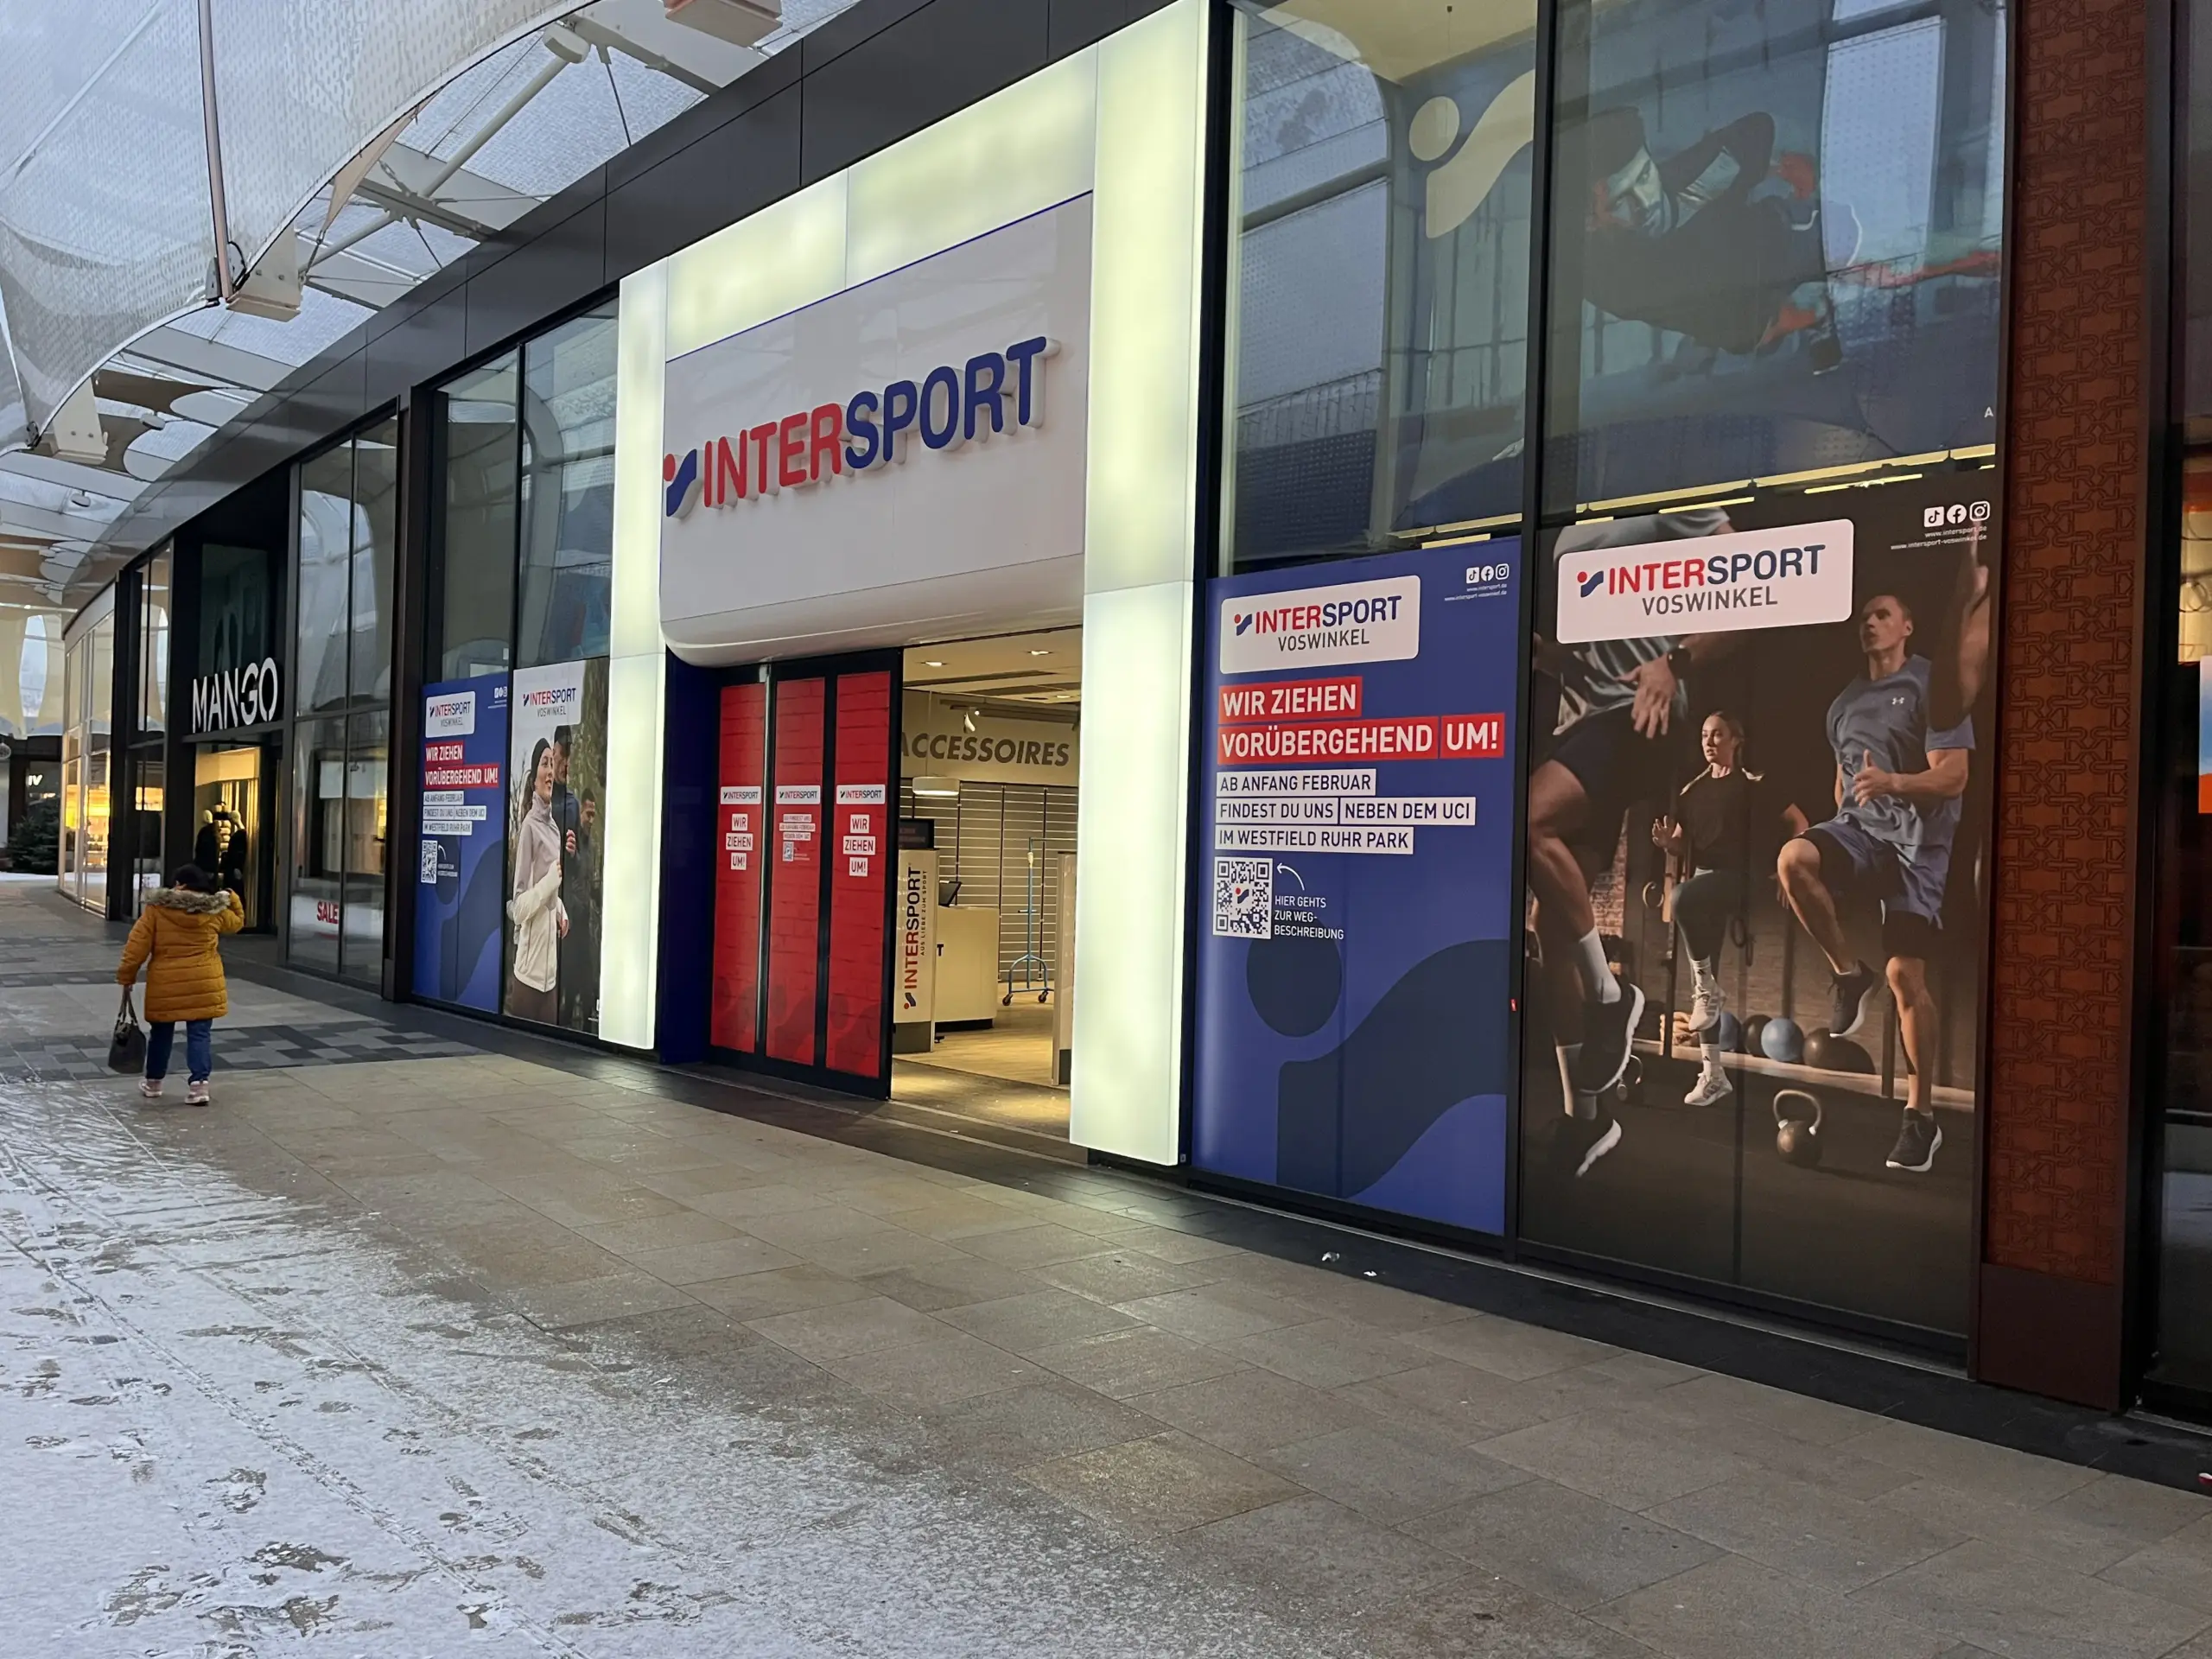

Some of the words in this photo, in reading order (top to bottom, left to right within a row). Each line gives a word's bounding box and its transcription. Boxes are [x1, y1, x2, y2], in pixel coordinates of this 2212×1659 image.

[702, 335, 1047, 508] INTERSPORT
[1608, 543, 1826, 595] INTERSPORT
[1642, 586, 1778, 616] VOSWINKEL
[1255, 595, 1402, 634] INTERSPORT
[1278, 628, 1370, 652] VOSWINKEL
[192, 657, 278, 734] MANGO
[530, 688, 576, 706] INTERSPORT
[1222, 690, 1265, 716] WIR
[1270, 684, 1357, 715] ZIEHEN
[435, 701, 471, 718] INTERSPORT
[537, 706, 566, 717] VOSWINKEL
[1221, 725, 1433, 758] VORÜBERGEHEND
[1446, 721, 1498, 751] UM!
[426, 747, 439, 761] WIR
[439, 745, 463, 760] ZIEHEN
[425, 767, 482, 785] VORÜBERGEHEND
[484, 767, 499, 783] UM!
[1220, 777, 1238, 791] AB
[1242, 775, 1298, 791] ANFANG
[1302, 774, 1371, 791] FEBRUAR
[846, 790, 882, 798] INTERSPORT
[1220, 804, 1276, 818] FINDEST
[1281, 804, 1300, 818] DU
[1304, 804, 1333, 818] UNS
[1344, 804, 1397, 819] NEBEN
[1402, 804, 1437, 819] DEM
[1442, 804, 1470, 819] UCI
[734, 817, 747, 828] WIR
[851, 818, 868, 830] WIR
[727, 836, 752, 848] ZIEHEN
[844, 839, 874, 852] ZIEHEN
[1219, 830, 1234, 845] IM
[1237, 830, 1316, 847] WESTFIELD
[1320, 831, 1361, 848] RUHR
[1367, 832, 1408, 849] PARK
[733, 856, 746, 867] UM!
[851, 861, 867, 873] UM!
[1274, 895, 1295, 906] HIER
[1297, 897, 1326, 908] GEHTS
[316, 900, 340, 925] SALE
[1274, 909, 1292, 921] ZUR
[1294, 911, 1318, 923] WEG-
[904, 866, 921, 989] INTERSPORT
[1274, 925, 1344, 939] BESCHREIBUNG
